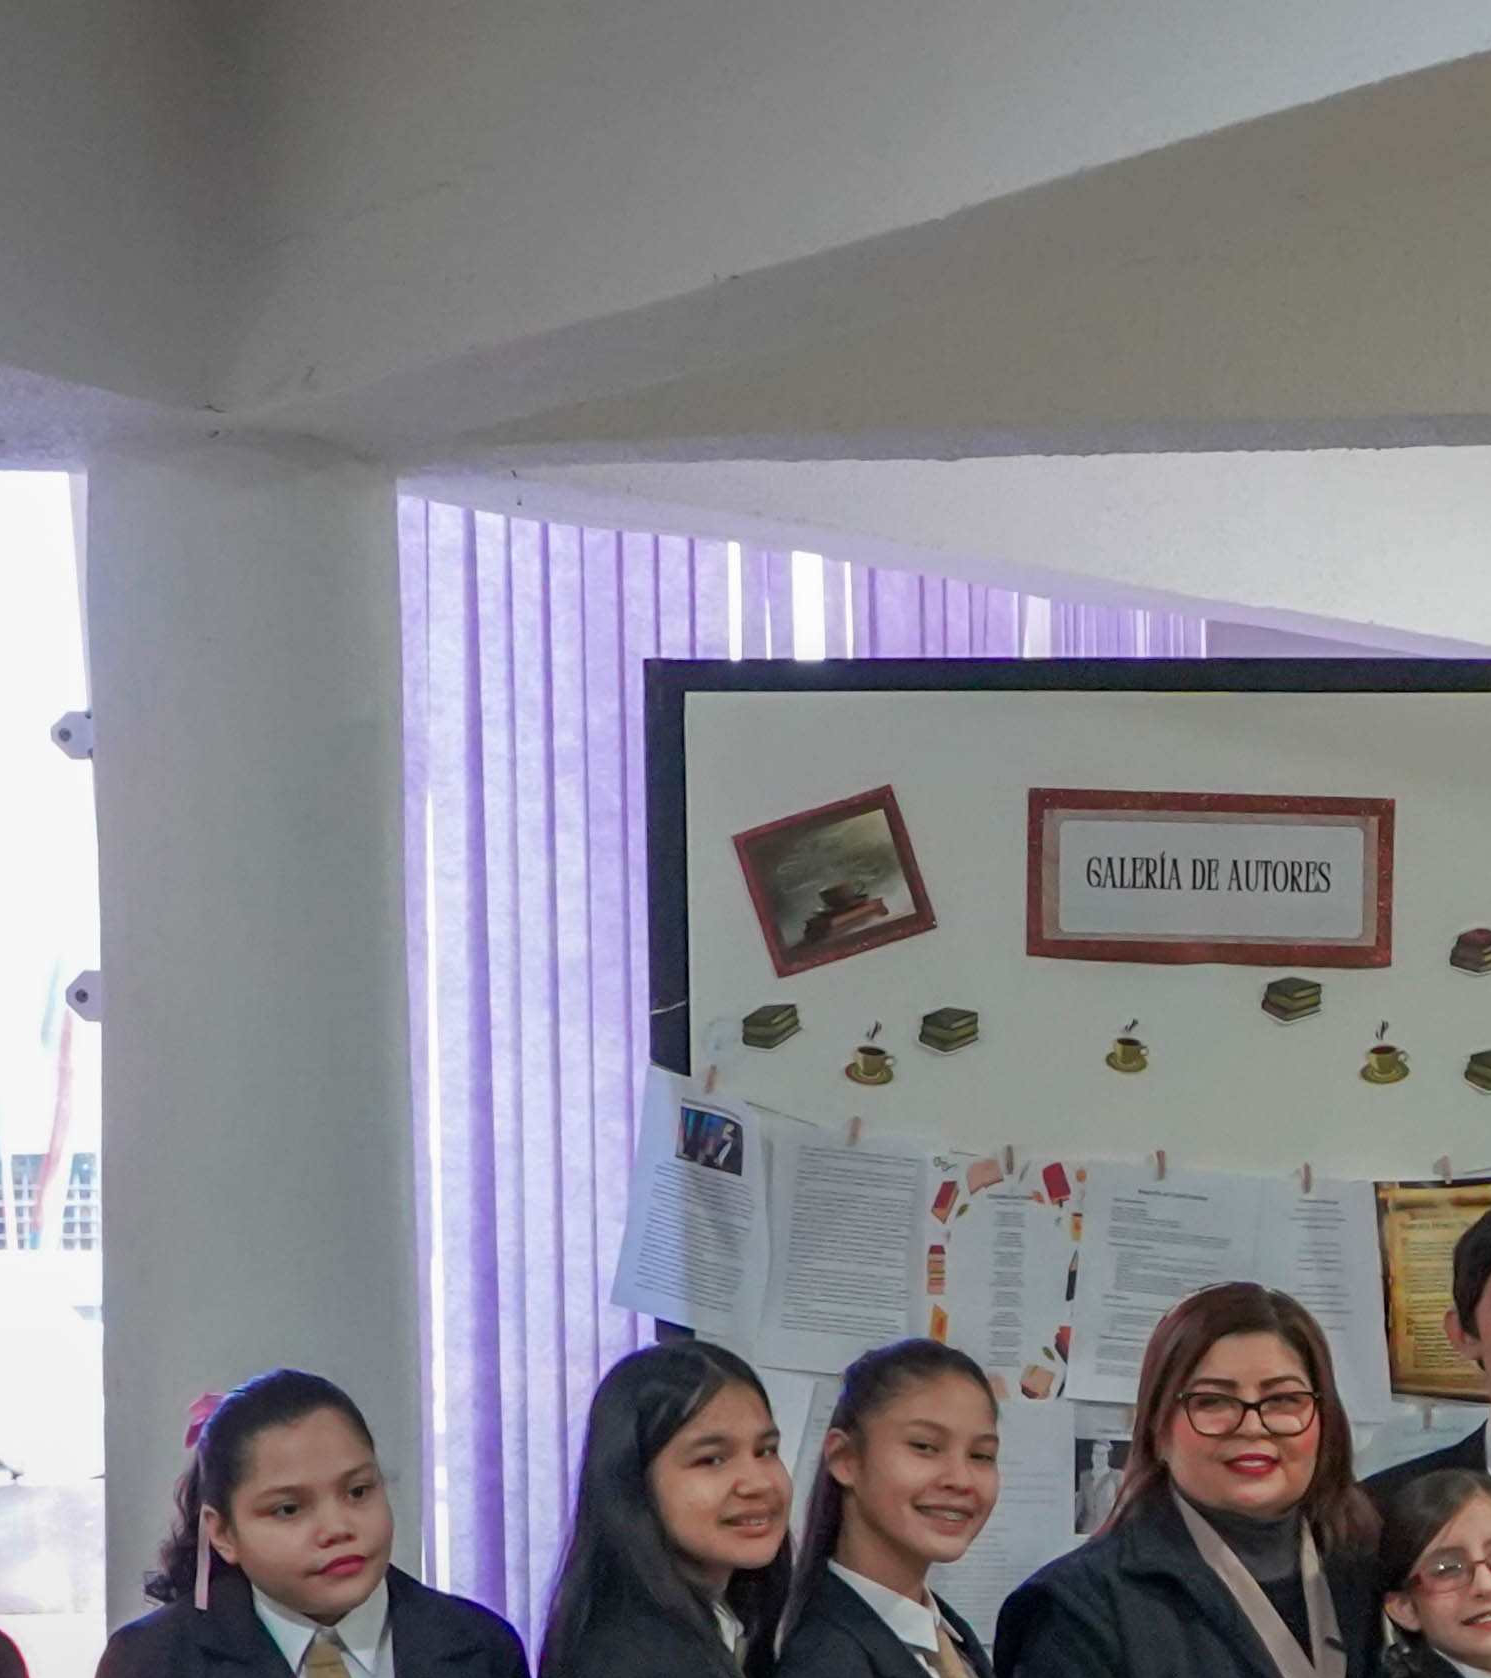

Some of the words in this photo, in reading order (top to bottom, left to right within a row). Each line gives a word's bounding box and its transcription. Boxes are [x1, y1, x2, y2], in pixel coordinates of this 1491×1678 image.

[1086, 851, 1183, 890] GALERÍA
[1191, 857, 1220, 892] DE
[1227, 858, 1332, 894] AUTORES
